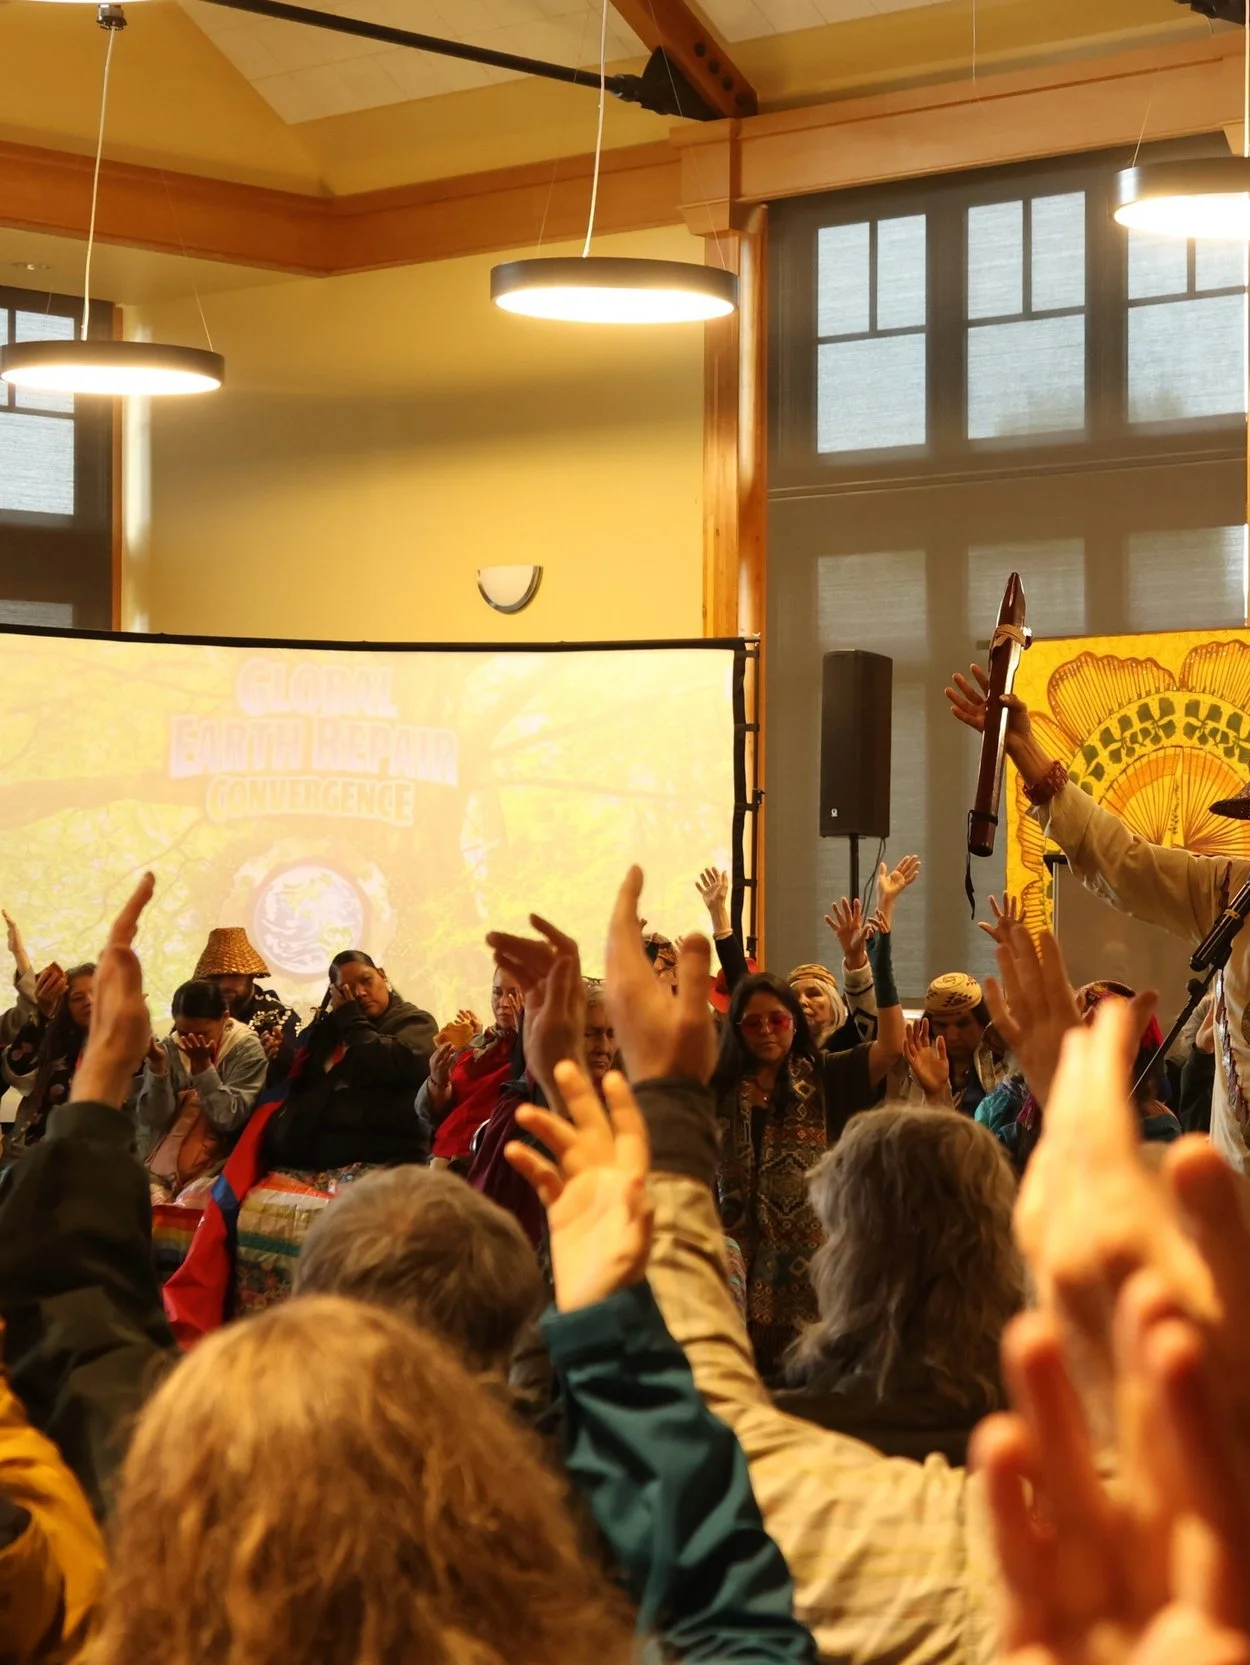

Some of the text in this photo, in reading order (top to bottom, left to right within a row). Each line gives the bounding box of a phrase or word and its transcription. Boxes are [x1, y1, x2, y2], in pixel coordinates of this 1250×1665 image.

[239, 660, 396, 716] GLOBAL
[171, 716, 458, 786] EARTH REPAIR
[208, 777, 413, 825] CONVERGENCE
